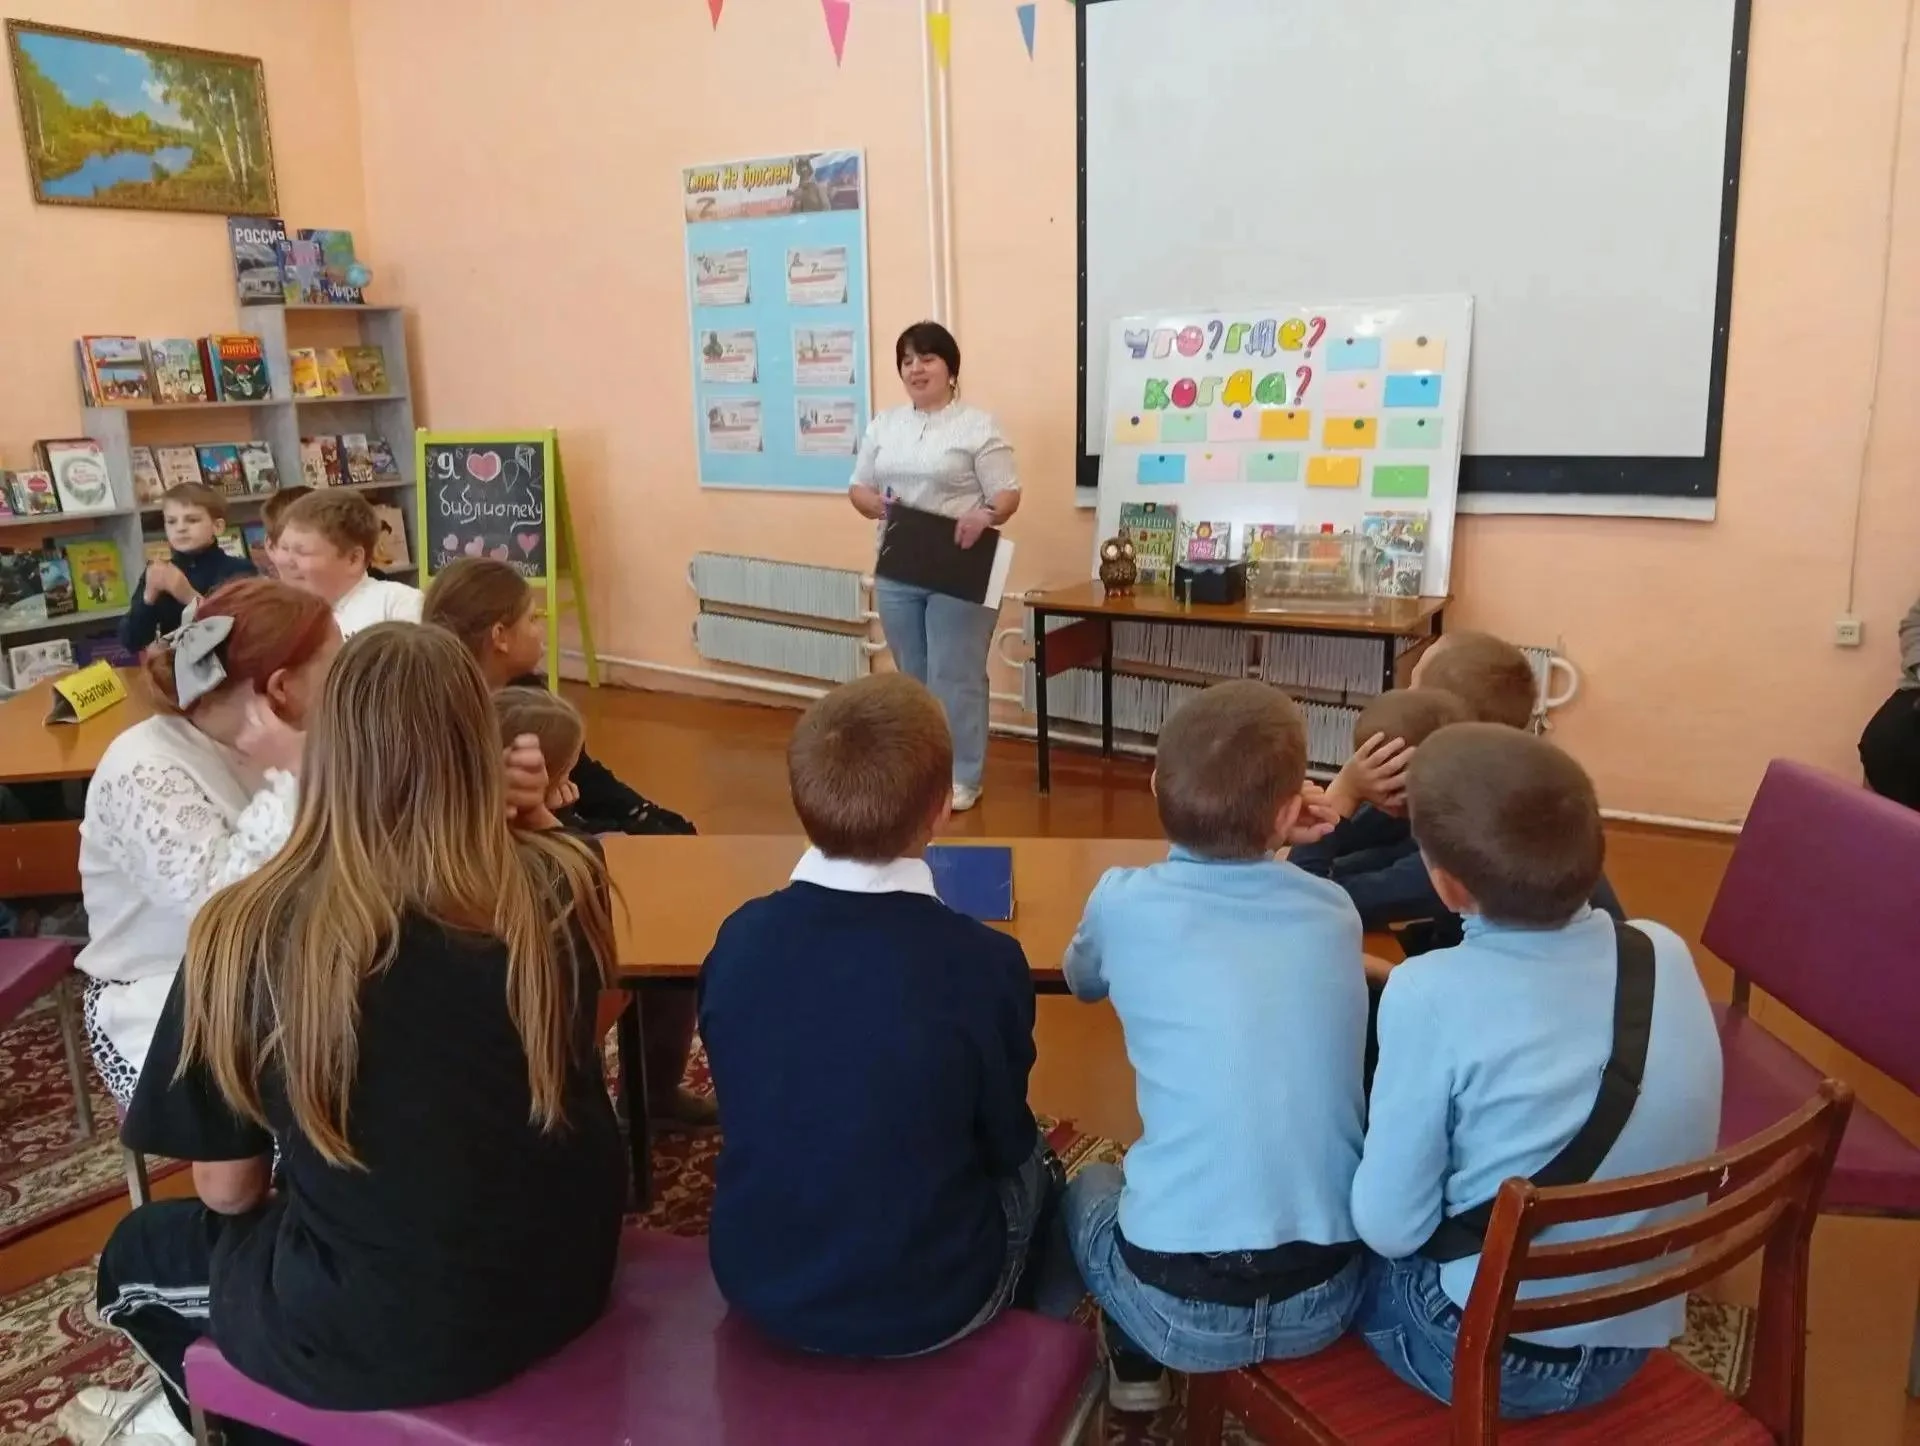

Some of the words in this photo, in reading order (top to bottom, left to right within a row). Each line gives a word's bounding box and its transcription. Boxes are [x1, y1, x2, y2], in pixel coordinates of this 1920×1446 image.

[235, 228, 285, 244] РОССИЯ
[439, 484, 543, 533] библиотеку
[72, 679, 115, 708] Знатоки
